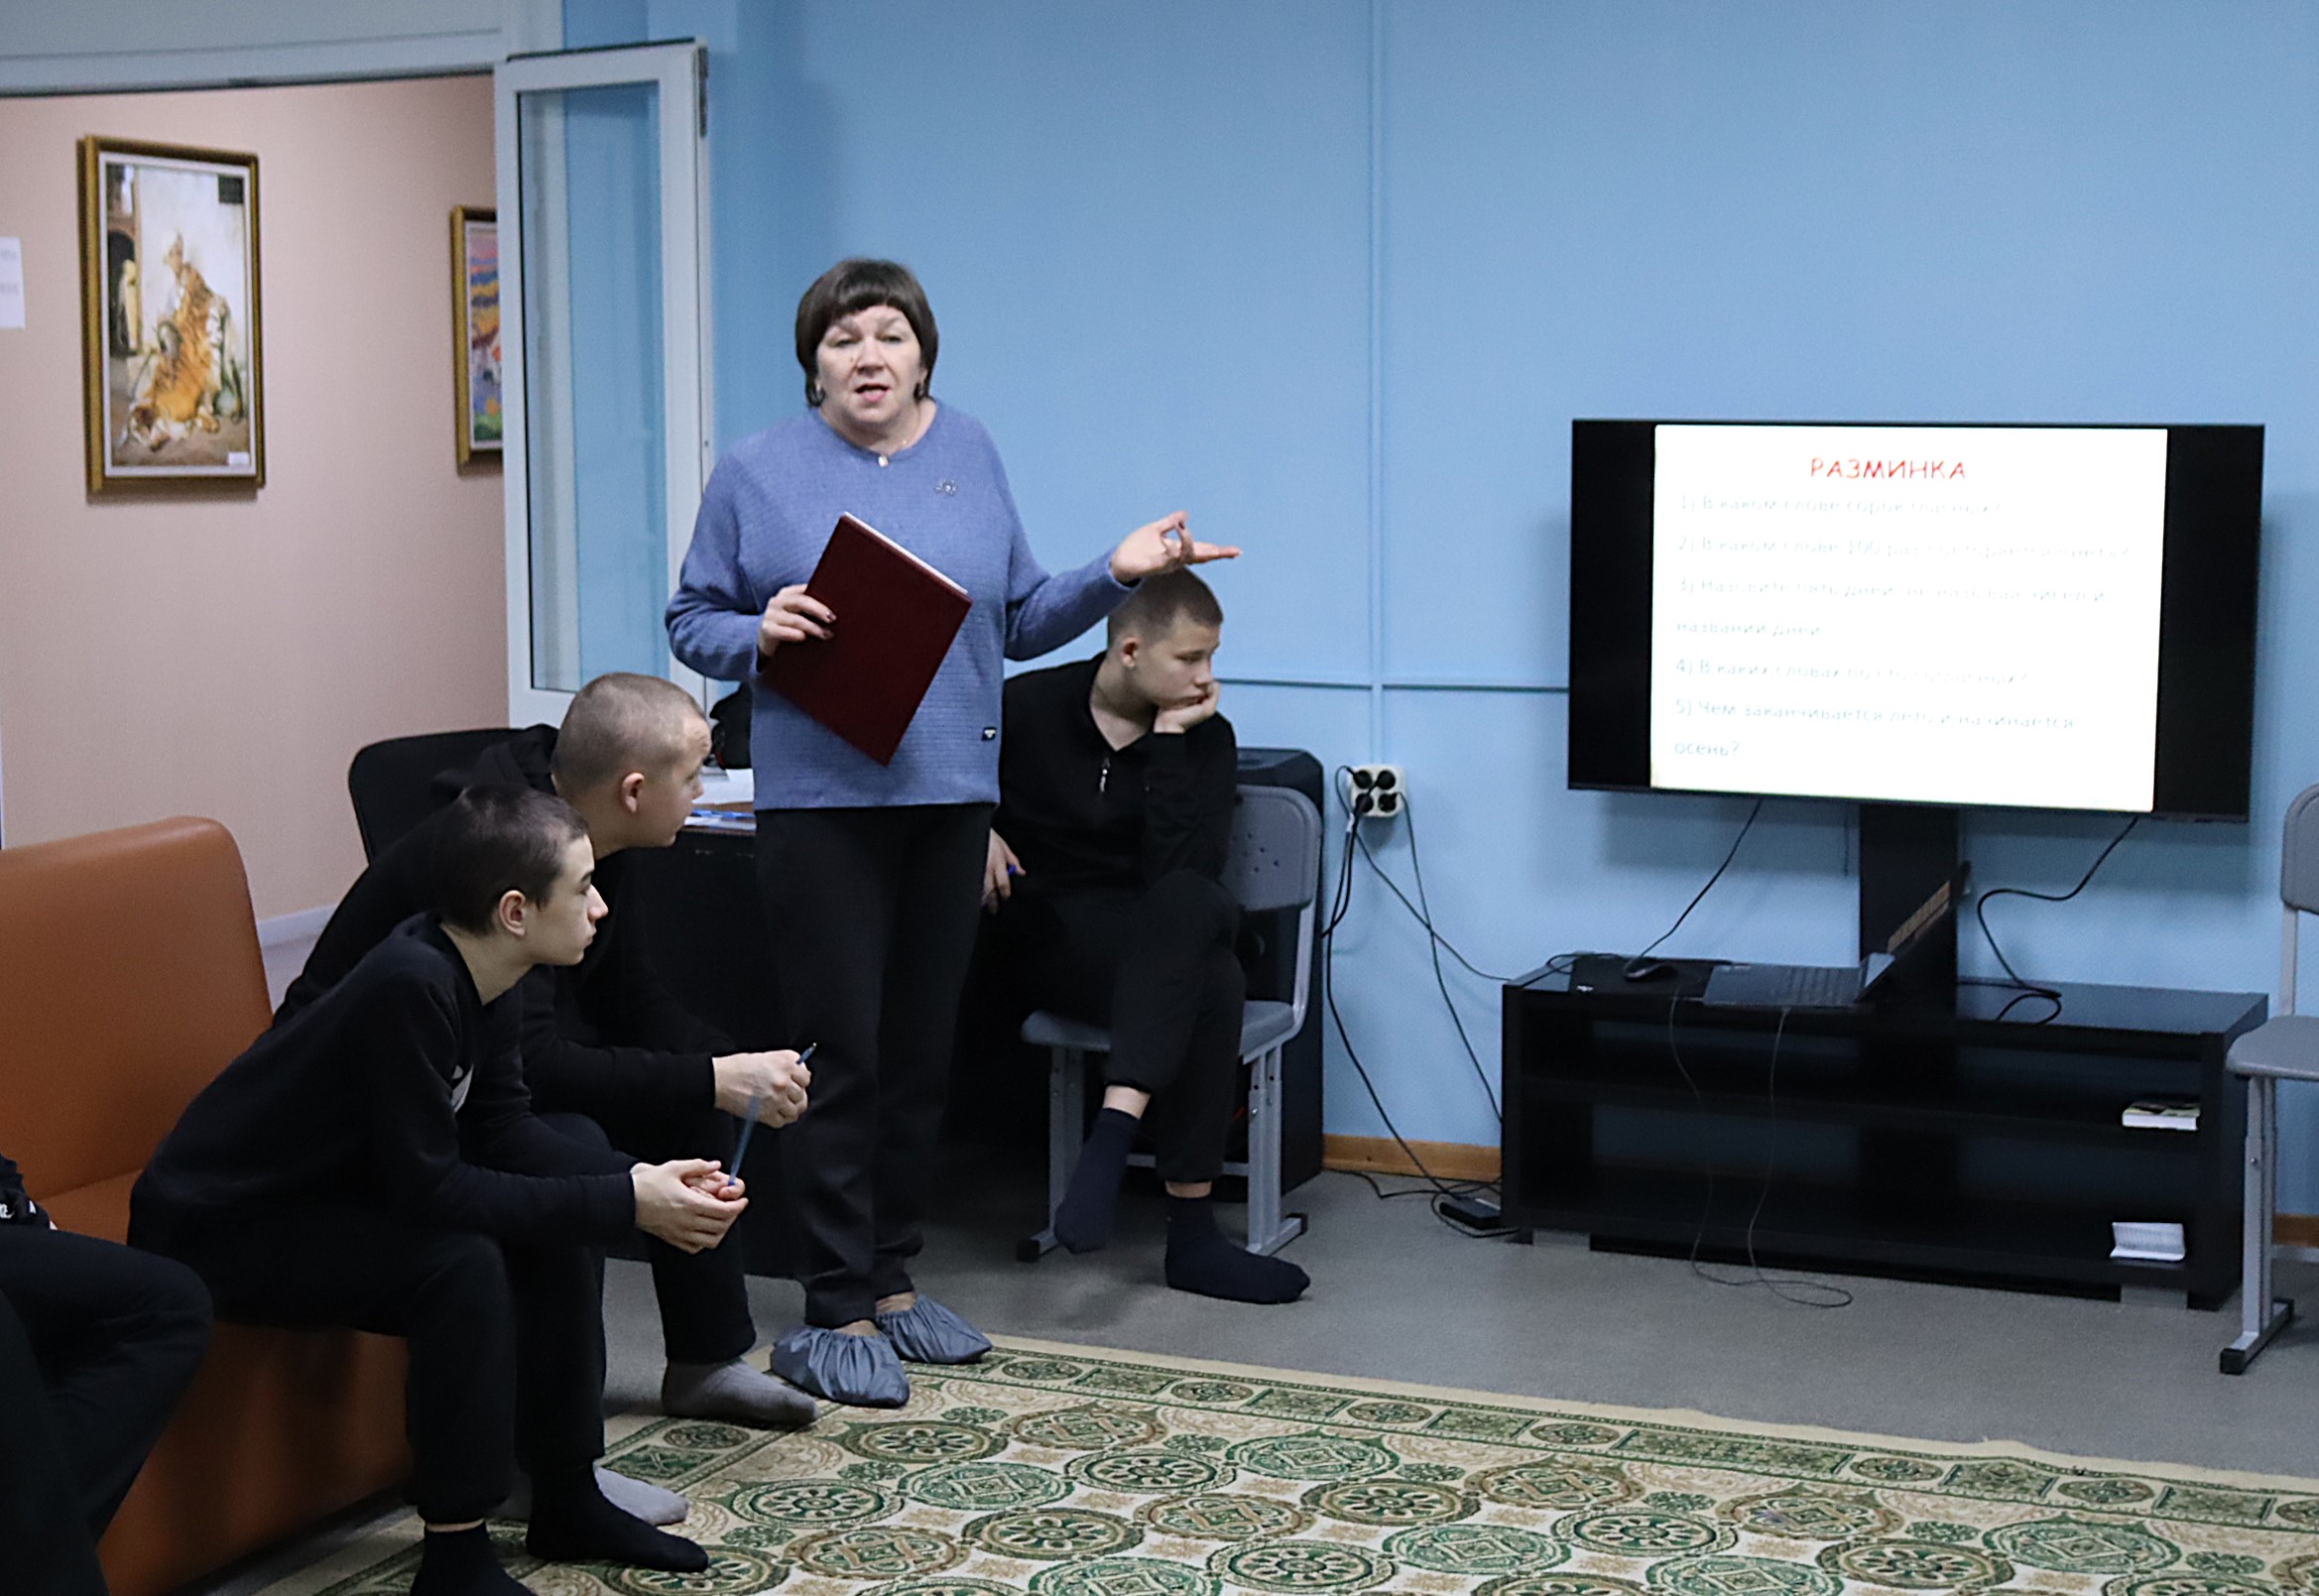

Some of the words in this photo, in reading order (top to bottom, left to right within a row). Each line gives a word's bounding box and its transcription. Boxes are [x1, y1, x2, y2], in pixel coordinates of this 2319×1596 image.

[1810, 456, 1966, 480] РАЗМИНКА
[1703, 494, 1714, 510] В
[1702, 536, 1713, 551] В
[1847, 539, 1881, 554] 100
[1675, 658, 1692, 675] 4)
[1699, 659, 1710, 675] В
[1675, 698, 1692, 716] 5)
[1699, 700, 1737, 715] Чем
[1674, 739, 1741, 756] осень?
